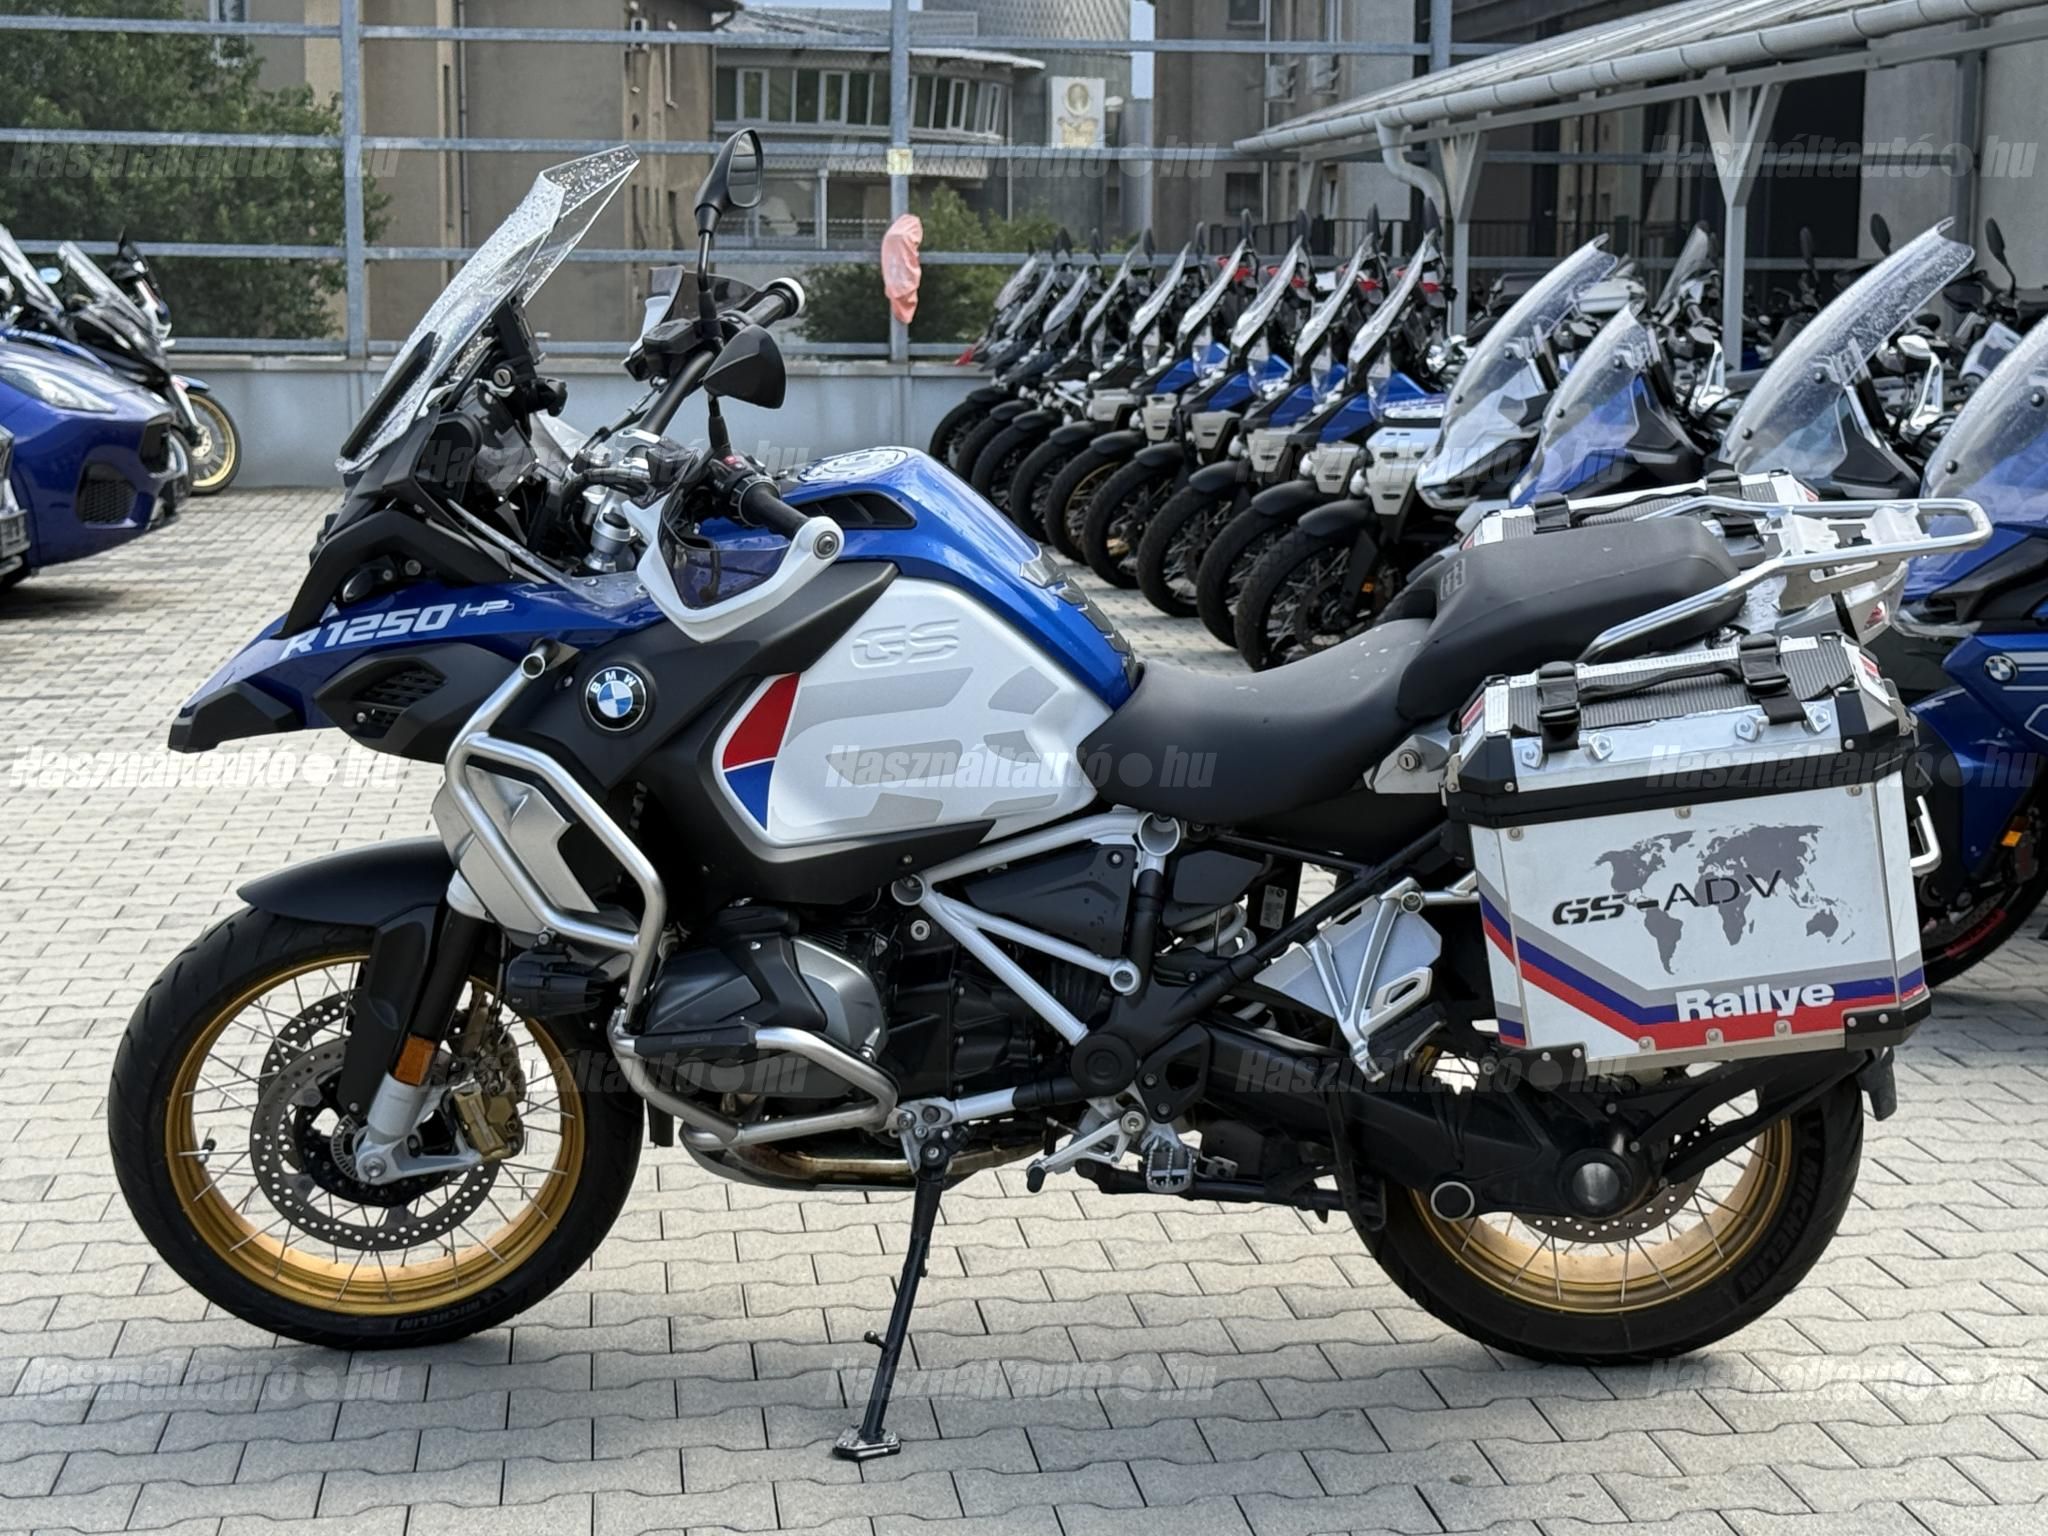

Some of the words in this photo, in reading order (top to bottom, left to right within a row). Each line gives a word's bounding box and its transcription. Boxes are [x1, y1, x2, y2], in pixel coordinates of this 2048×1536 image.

[279, 626, 321, 661] R
[324, 603, 457, 648] 1250
[458, 599, 515, 618] HP
[850, 619, 960, 669] GS
[590, 670, 637, 694] BMW
[1552, 869, 1782, 926] GS-ADV
[1675, 983, 1835, 1023] Rallye
[1740, 1155, 1818, 1293] MICHELIN
[399, 1298, 482, 1331] MICHELIN
